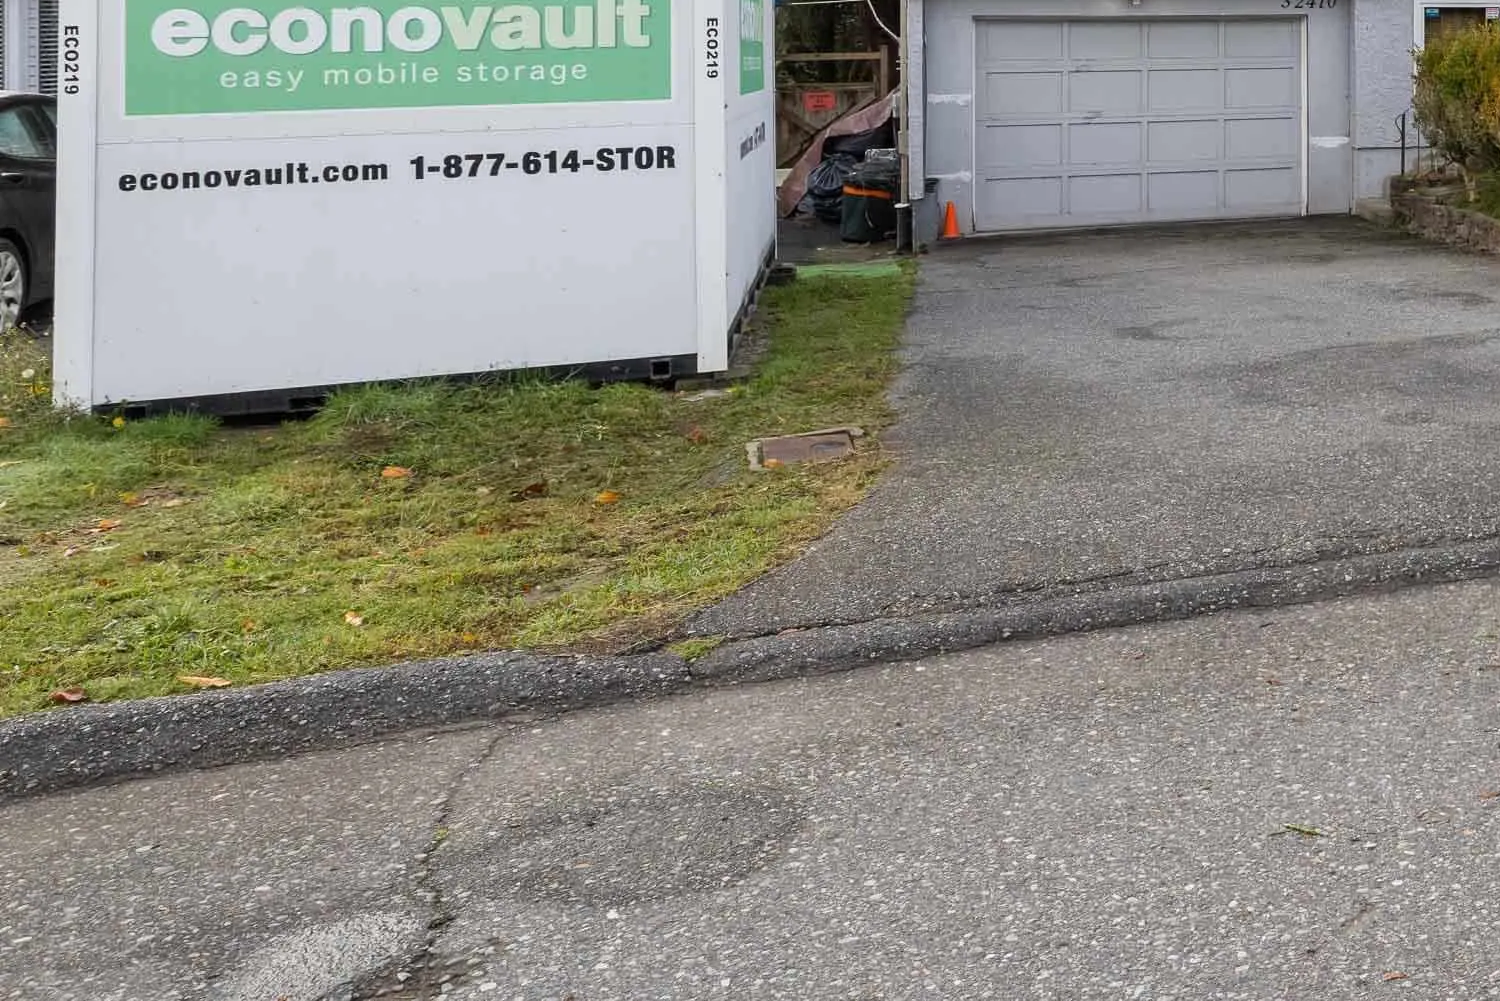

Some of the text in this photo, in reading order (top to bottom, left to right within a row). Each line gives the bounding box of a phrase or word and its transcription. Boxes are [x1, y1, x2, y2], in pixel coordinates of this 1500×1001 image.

[64, 25, 80, 95] ECO219
[706, 17, 719, 79] ECO219
[219, 61, 588, 92] easy mobile storage
[118, 145, 676, 192] econovault.com 1-877-614-STOR
